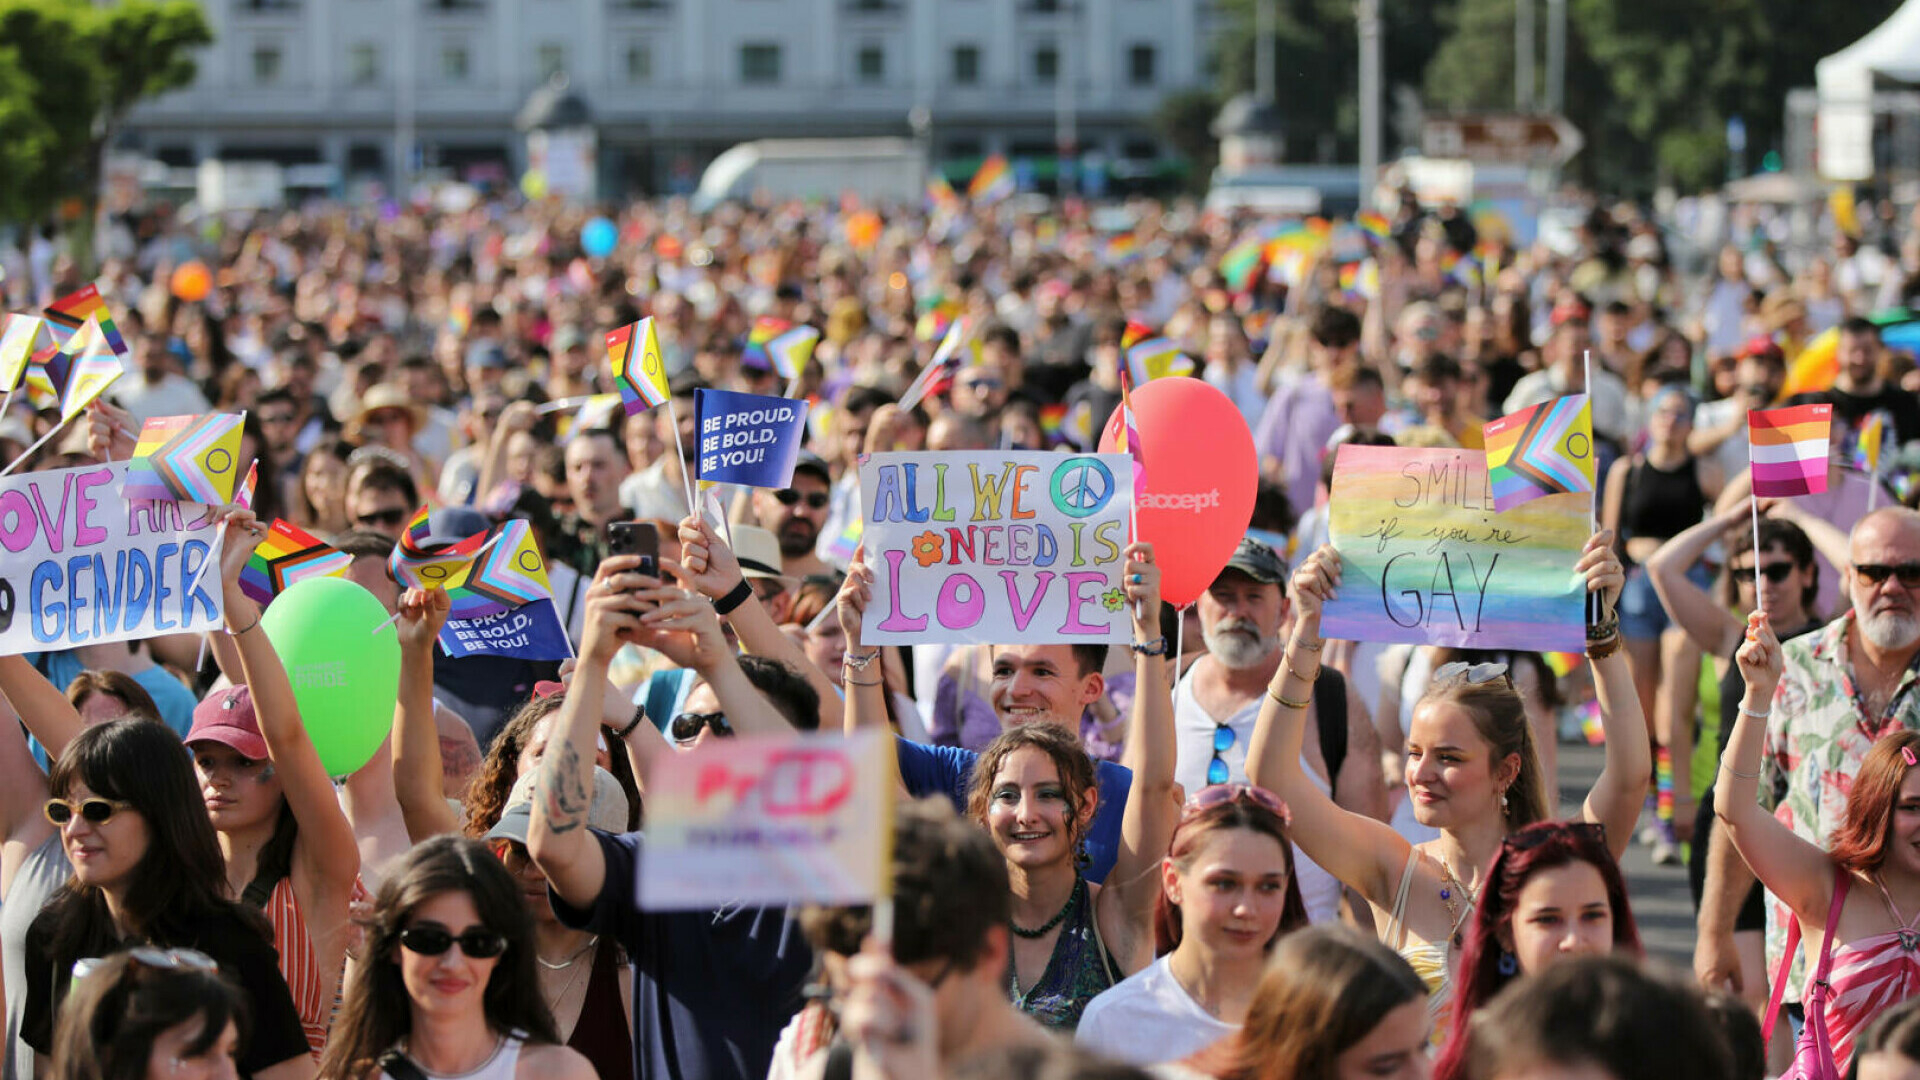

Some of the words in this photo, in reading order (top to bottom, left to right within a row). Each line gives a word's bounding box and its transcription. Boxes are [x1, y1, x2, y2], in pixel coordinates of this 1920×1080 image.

[703, 416, 722, 434] BE
[725, 407, 796, 429] PROUD,
[702, 435, 720, 454] BE
[722, 428, 778, 449] BOLD,
[701, 455, 718, 474] BE
[720, 447, 766, 468] YOU!
[872, 462, 956, 523] ALL
[967, 461, 1040, 522] WE
[1140, 488, 1220, 514] accept
[944, 524, 1059, 568] NEED
[1068, 520, 1121, 568] IS
[1360, 517, 1404, 554] if
[30, 539, 219, 644] GENDER
[877, 549, 1111, 635] LOVE
[1381, 551, 1500, 633] GAY
[447, 619, 472, 630] BE
[471, 605, 520, 627] PRO
[455, 630, 479, 641] BE
[479, 613, 532, 639] BOLD,
[463, 639, 488, 651] BE
[486, 633, 530, 649] YOU!
